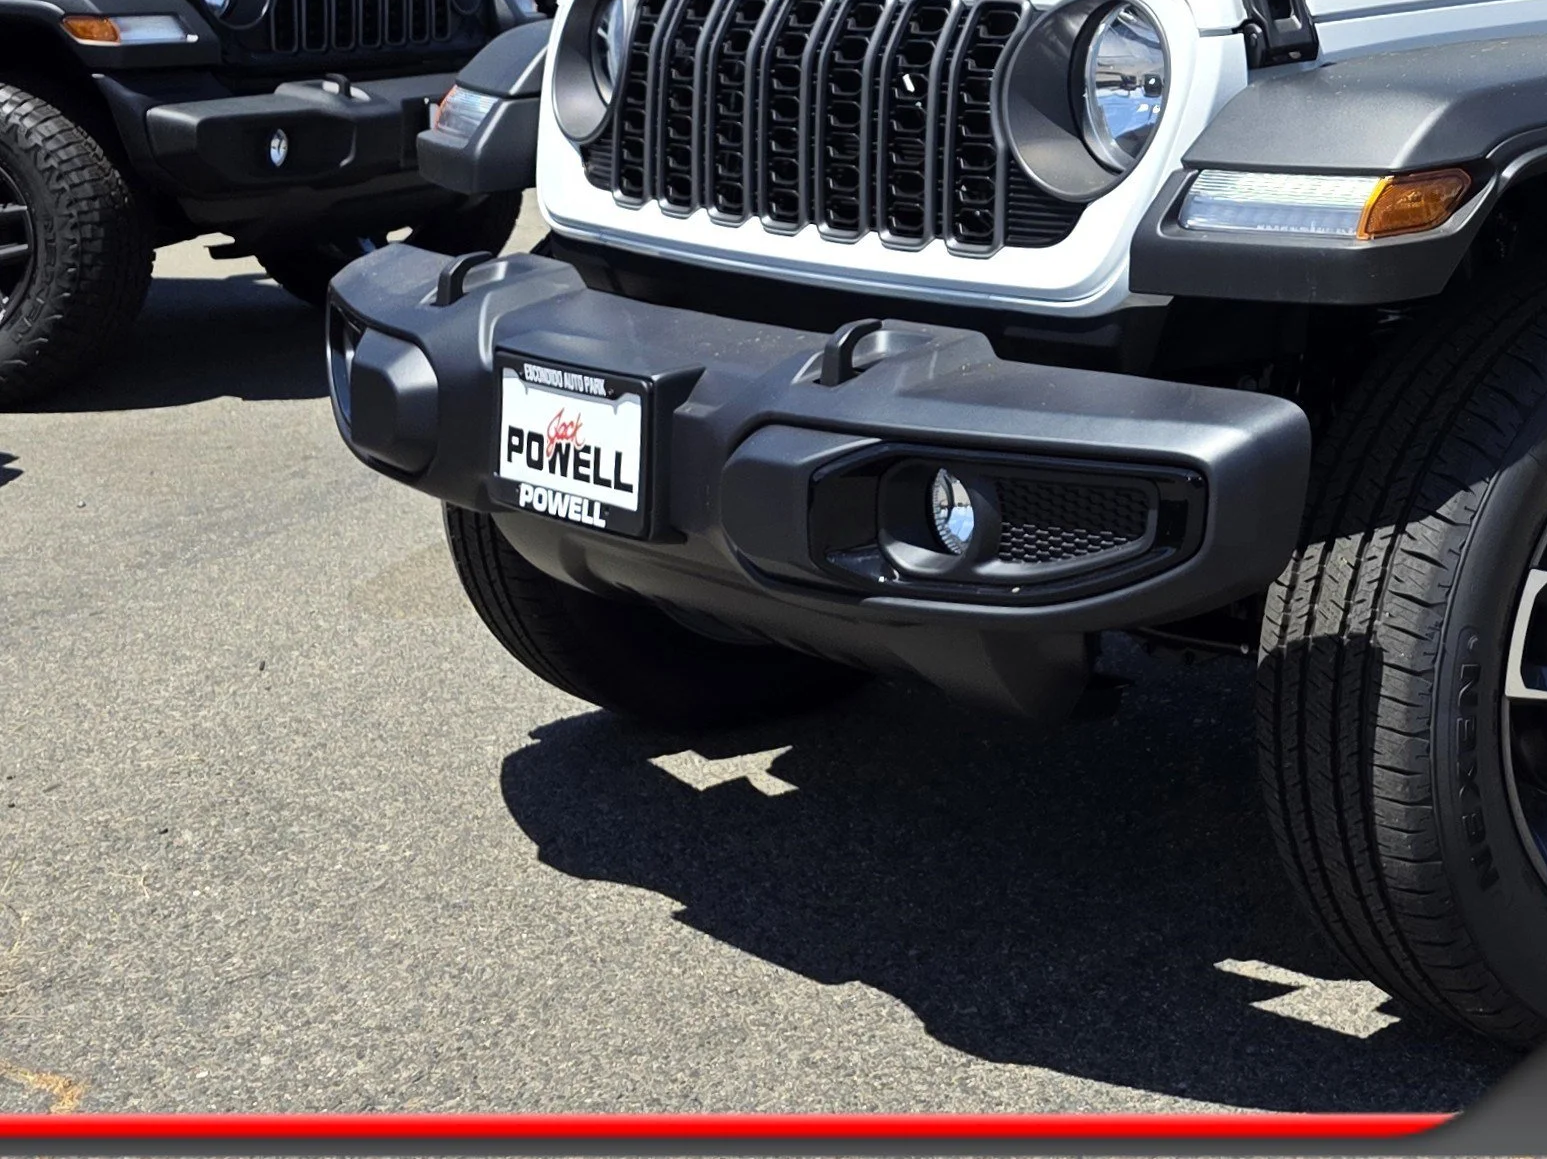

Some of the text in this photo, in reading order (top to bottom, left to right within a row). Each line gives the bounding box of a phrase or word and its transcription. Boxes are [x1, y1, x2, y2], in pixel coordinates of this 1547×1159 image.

[564, 372, 584, 393] AUTO
[583, 376, 607, 397] PARK
[546, 407, 586, 459] Jack
[507, 425, 634, 495] POWELL
[518, 483, 607, 528] POWELL
[1454, 662, 1500, 893] NEXEN
